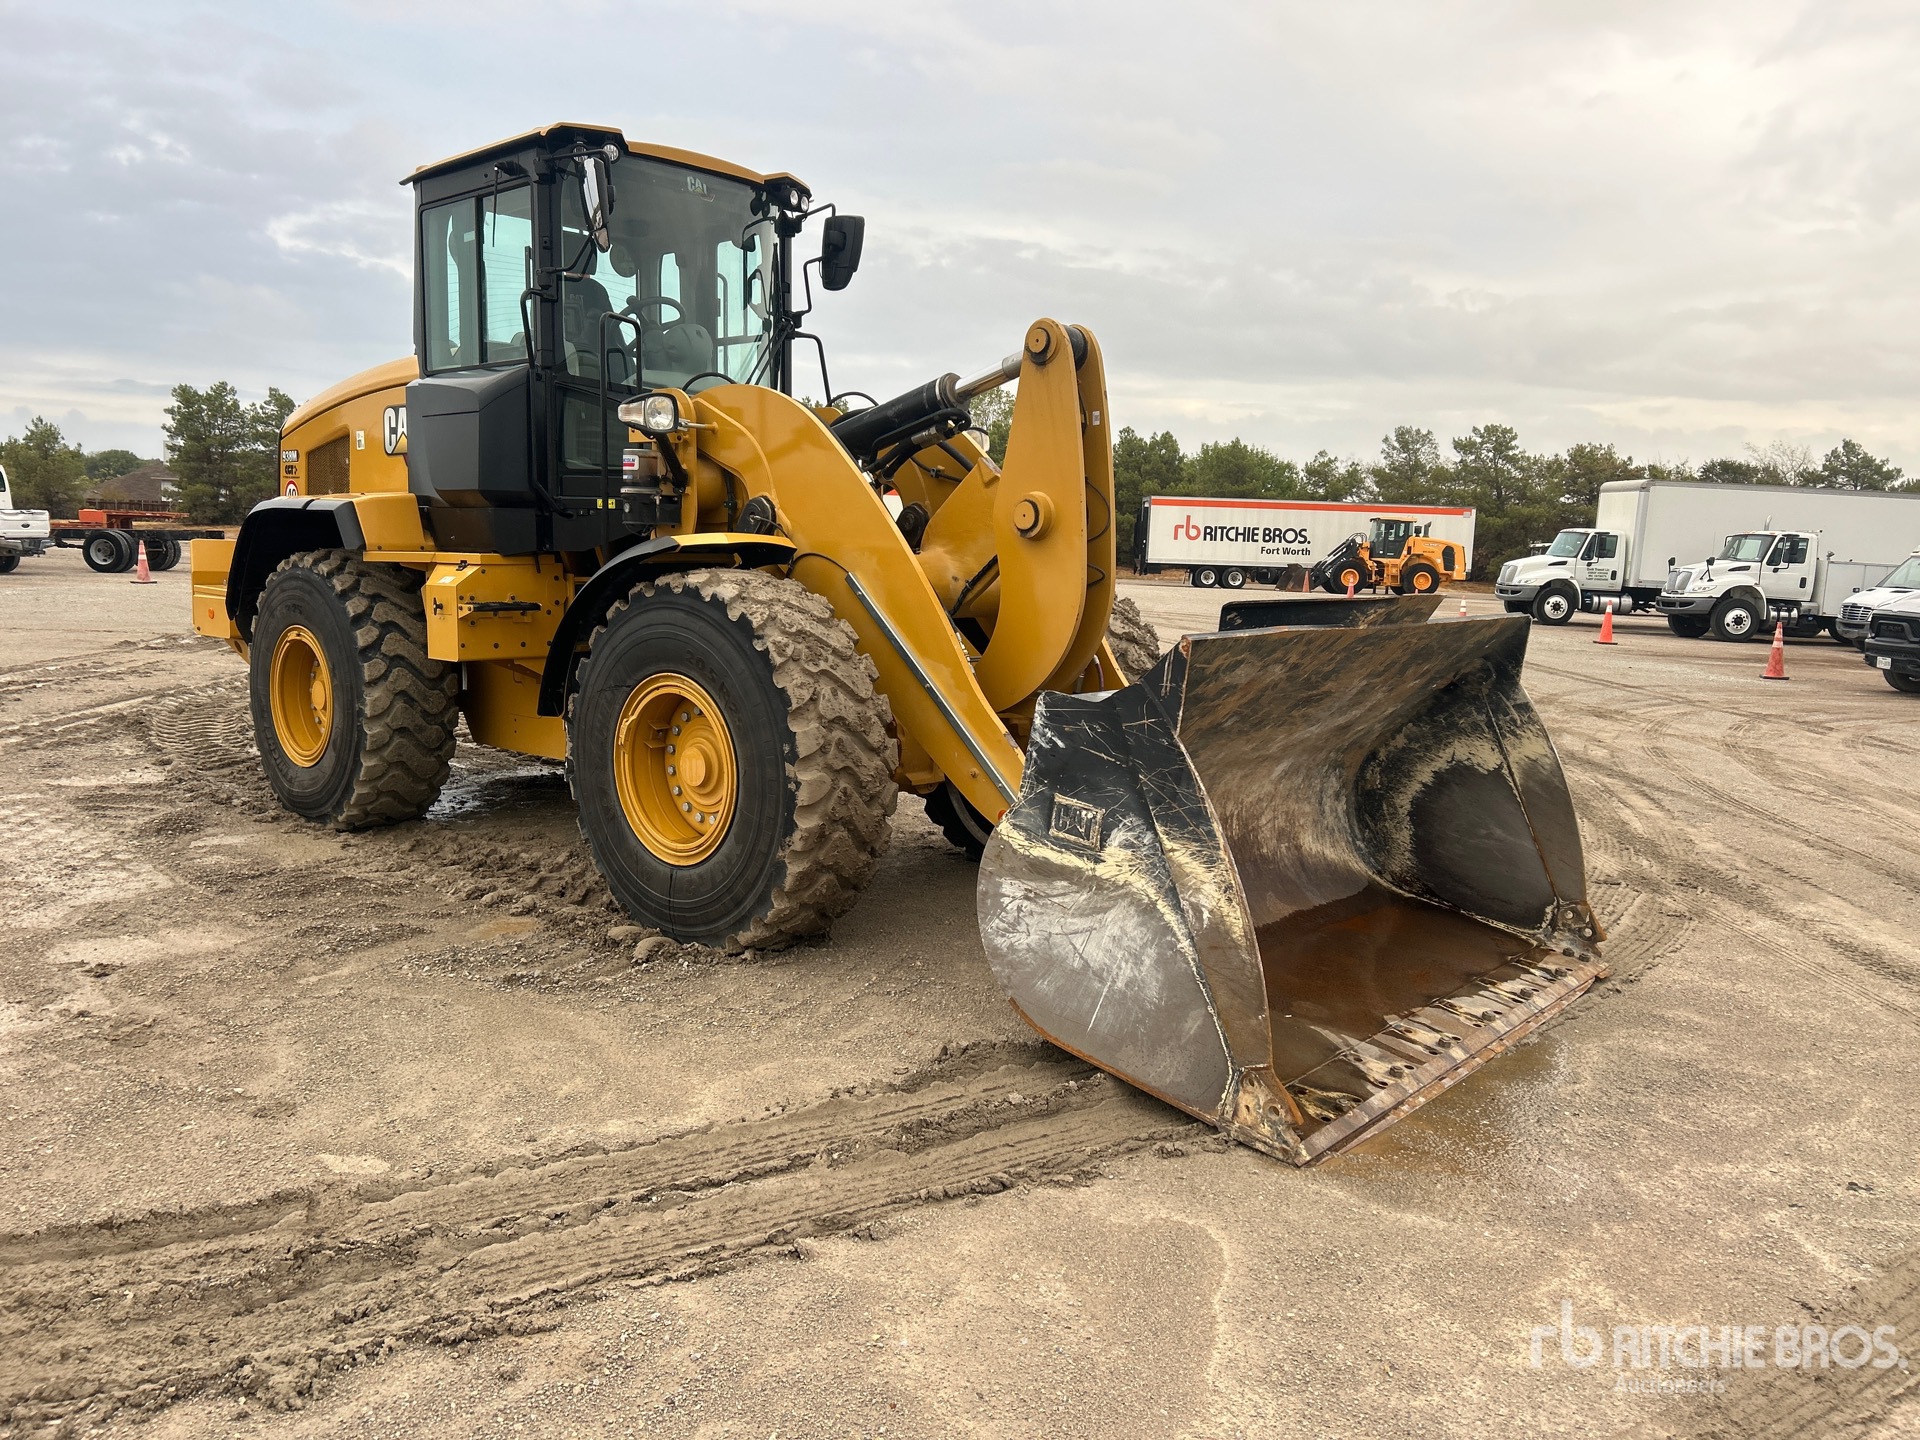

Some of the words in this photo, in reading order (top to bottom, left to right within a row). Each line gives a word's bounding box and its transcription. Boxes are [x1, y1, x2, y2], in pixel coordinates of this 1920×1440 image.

[384, 407, 408, 454] CA
[1174, 515, 1200, 540] rb
[1203, 526, 1260, 542] RITCHIE
[1262, 528, 1311, 544] BROS.
[1261, 547, 1280, 555] Fort
[1282, 547, 1311, 556] Worth
[1054, 804, 1096, 841] CAT
